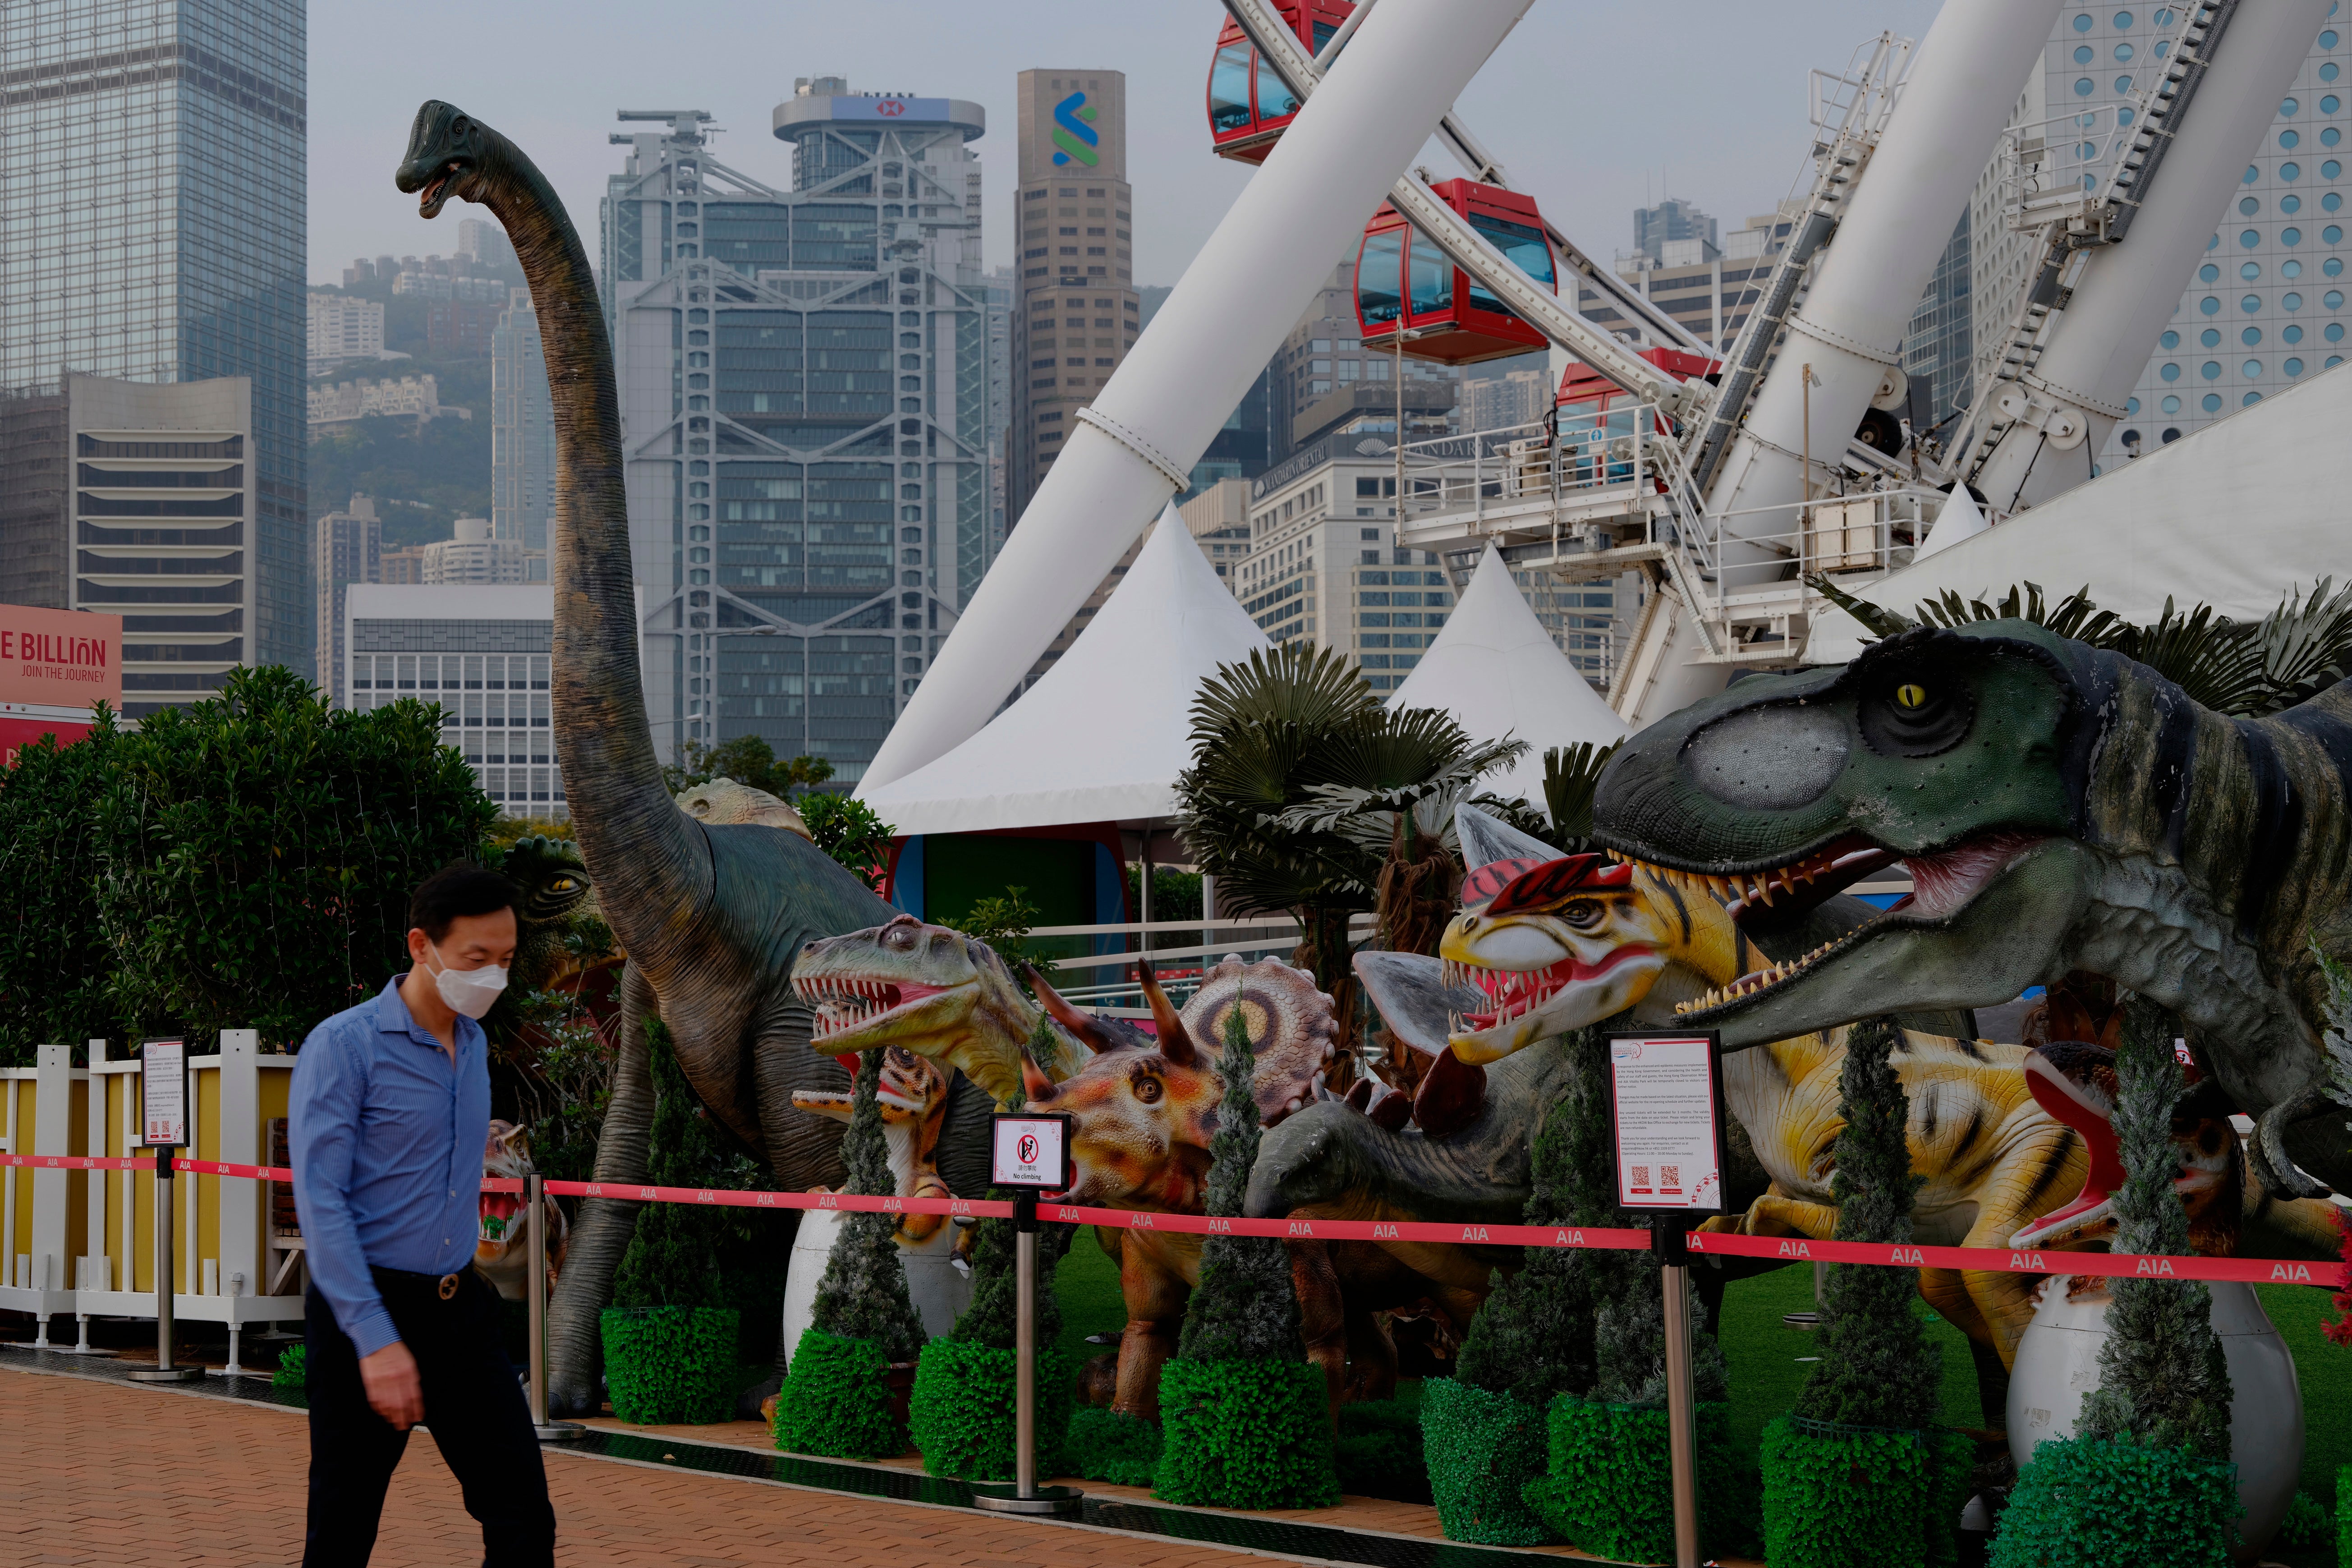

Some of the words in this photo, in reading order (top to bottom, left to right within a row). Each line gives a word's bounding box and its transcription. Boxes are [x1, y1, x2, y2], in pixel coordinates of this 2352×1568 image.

[1266, 462, 1295, 491] MANDARIN
[1295, 445, 1325, 474] ORIENTAL
[1, 631, 13, 659] E
[22, 665, 41, 677] JOIN
[45, 666, 62, 679] THE
[65, 668, 105, 682] JOURNEY
[12, 1157, 23, 1165] AIA
[47, 1158, 58, 1166] AIA
[83, 1159, 94, 1168] AIA
[120, 1159, 132, 1168] AIA
[179, 1161, 191, 1169] AIA
[218, 1164, 230, 1173] AIA
[257, 1168, 269, 1177] AIA
[586, 1185, 602, 1195] AIA
[641, 1188, 657, 1199] AIA
[698, 1191, 715, 1202] AIA
[757, 1194, 775, 1205] AIA
[819, 1196, 837, 1208] AIA
[883, 1199, 902, 1210] AIA
[950, 1202, 971, 1214] AIA
[1059, 1208, 1079, 1220] AIA
[1132, 1214, 1153, 1227] AIA
[1208, 1219, 1231, 1232] AIA
[1289, 1222, 1313, 1235] AIA
[1374, 1224, 1399, 1237] AIA
[1462, 1227, 1489, 1241] AIA
[1556, 1230, 1585, 1244] AIA
[1779, 1241, 1810, 1257] AIA
[1891, 1248, 1924, 1264] AIA
[2010, 1253, 2045, 1269] AIA
[2136, 1259, 2174, 1275] AIA
[2271, 1264, 2311, 1281] AIA
